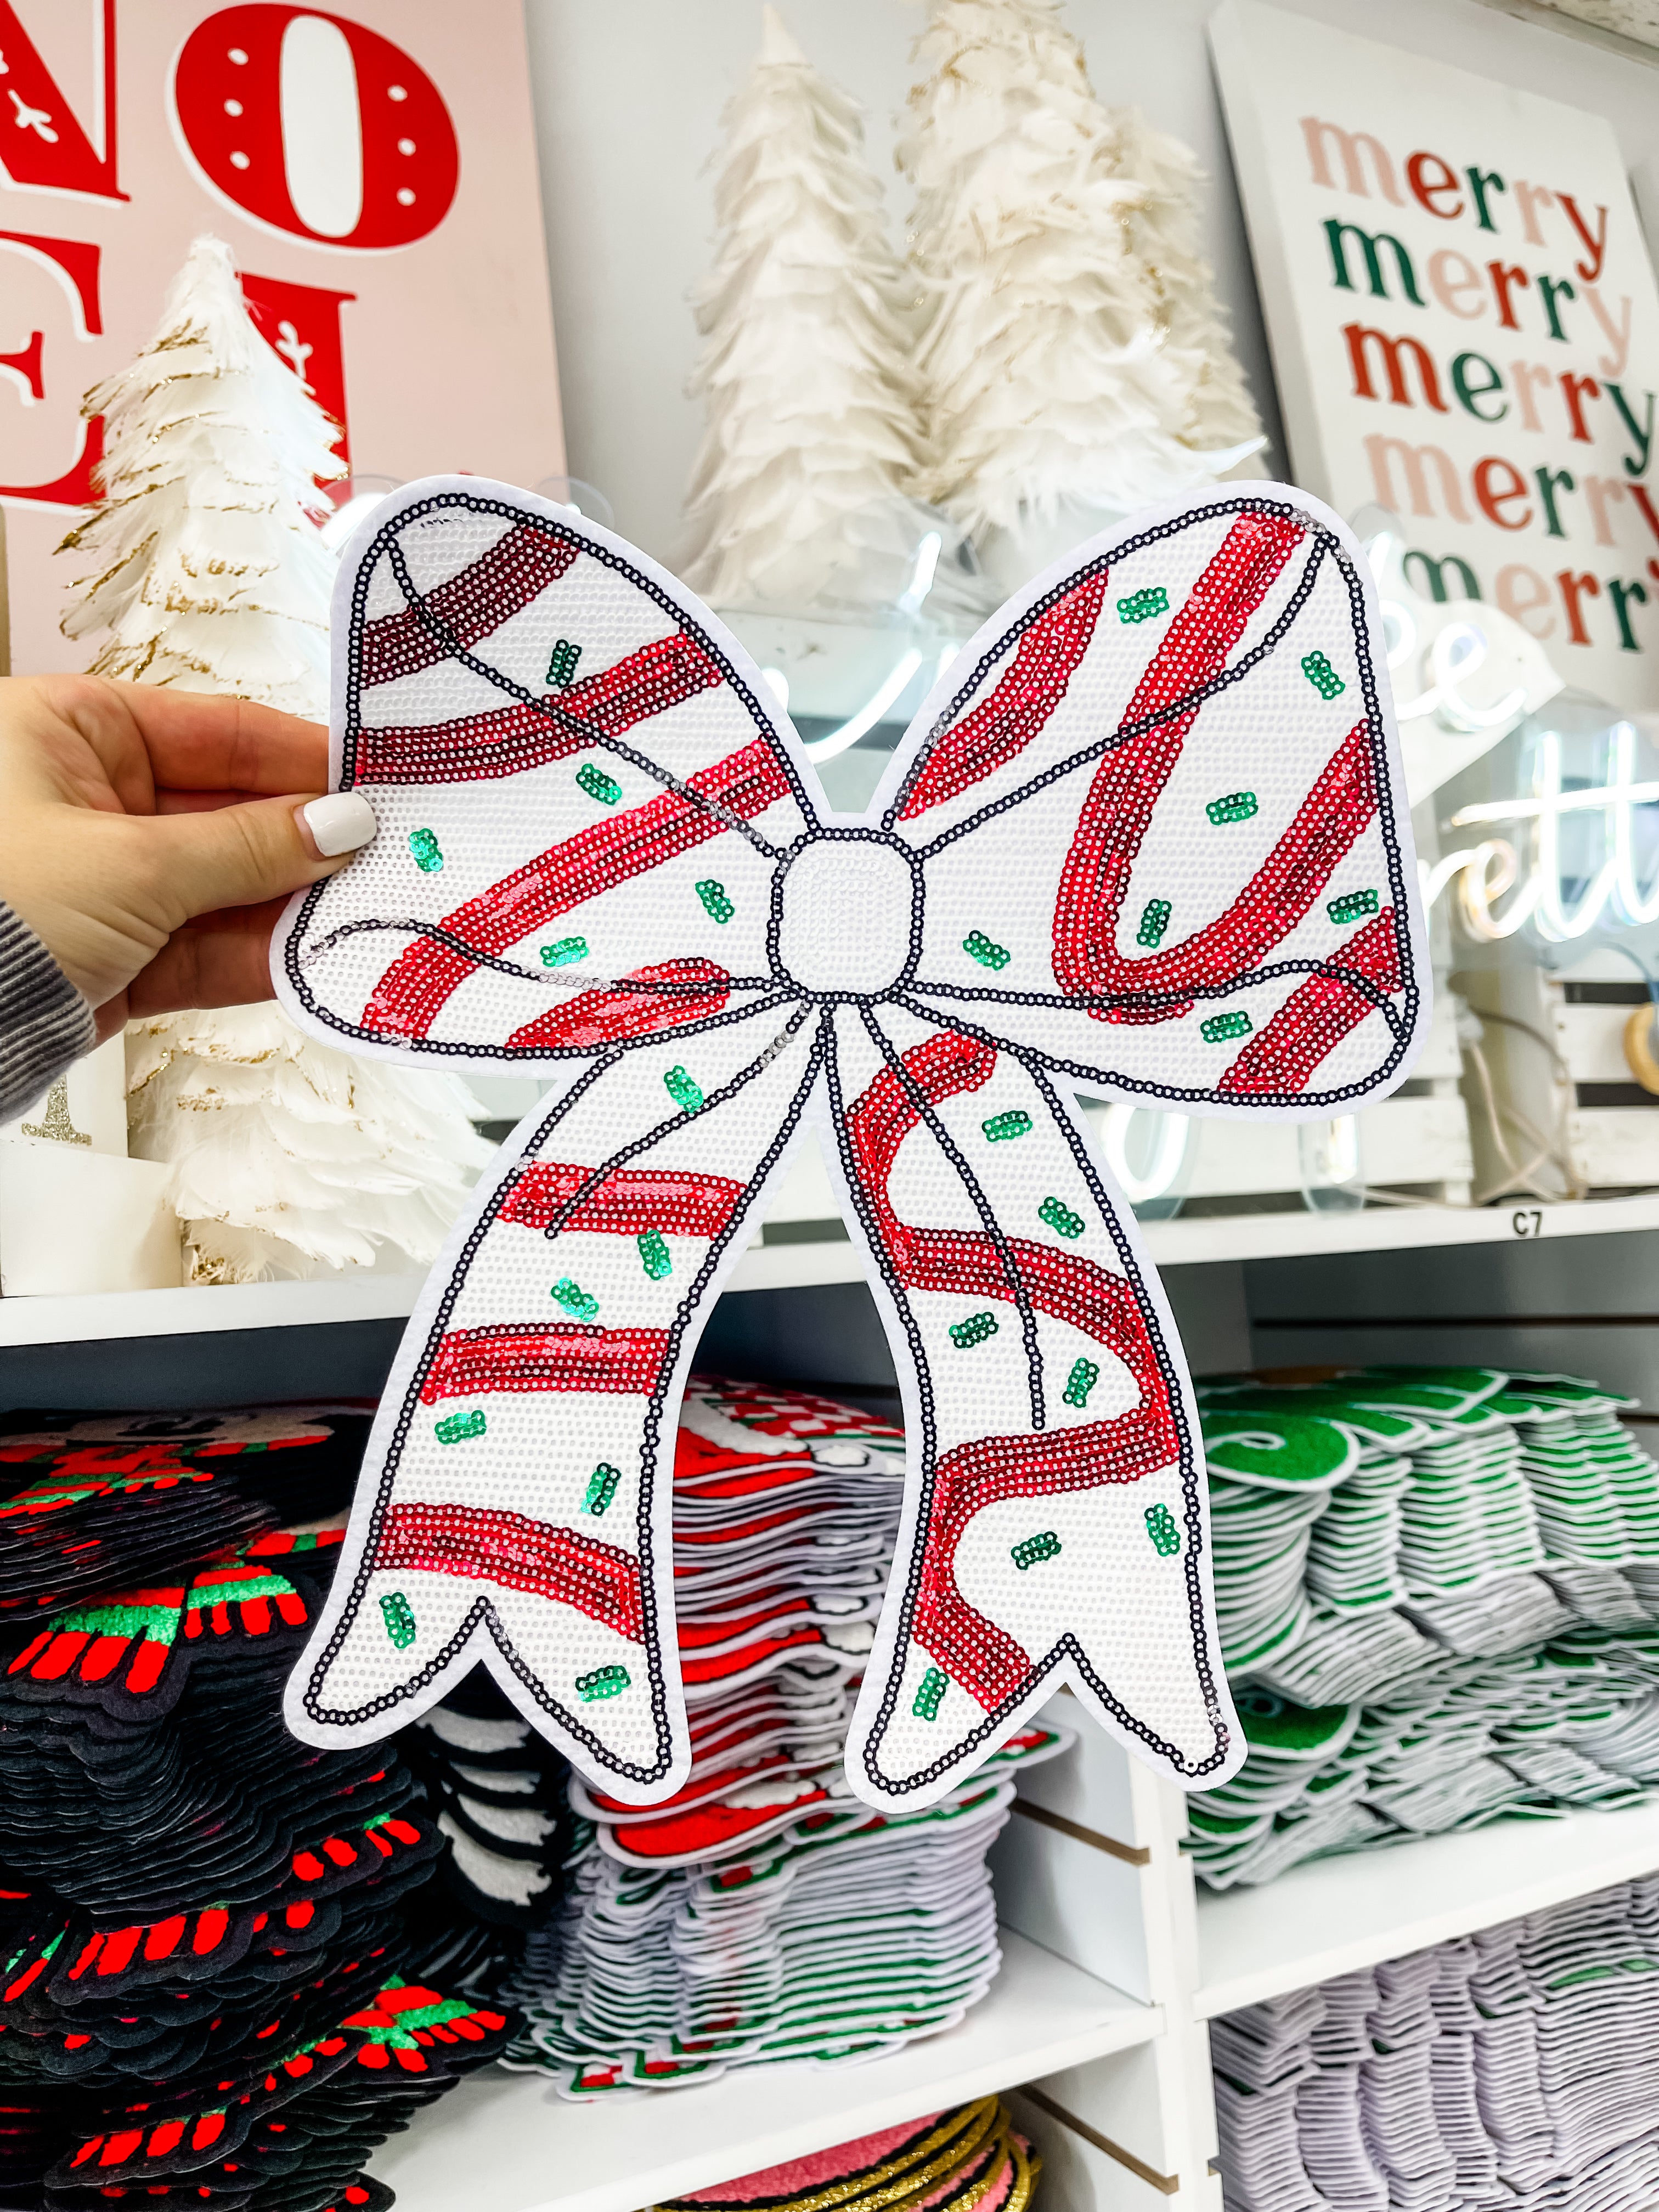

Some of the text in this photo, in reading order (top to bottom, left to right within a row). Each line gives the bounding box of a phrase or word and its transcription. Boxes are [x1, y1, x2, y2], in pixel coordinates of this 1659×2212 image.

[1299, 116, 1609, 282] merry
[1321, 218, 1631, 377] merry
[1342, 321, 1657, 475] merry
[1403, 550, 1659, 652] merr
[1513, 1211, 1542, 1237] C7
